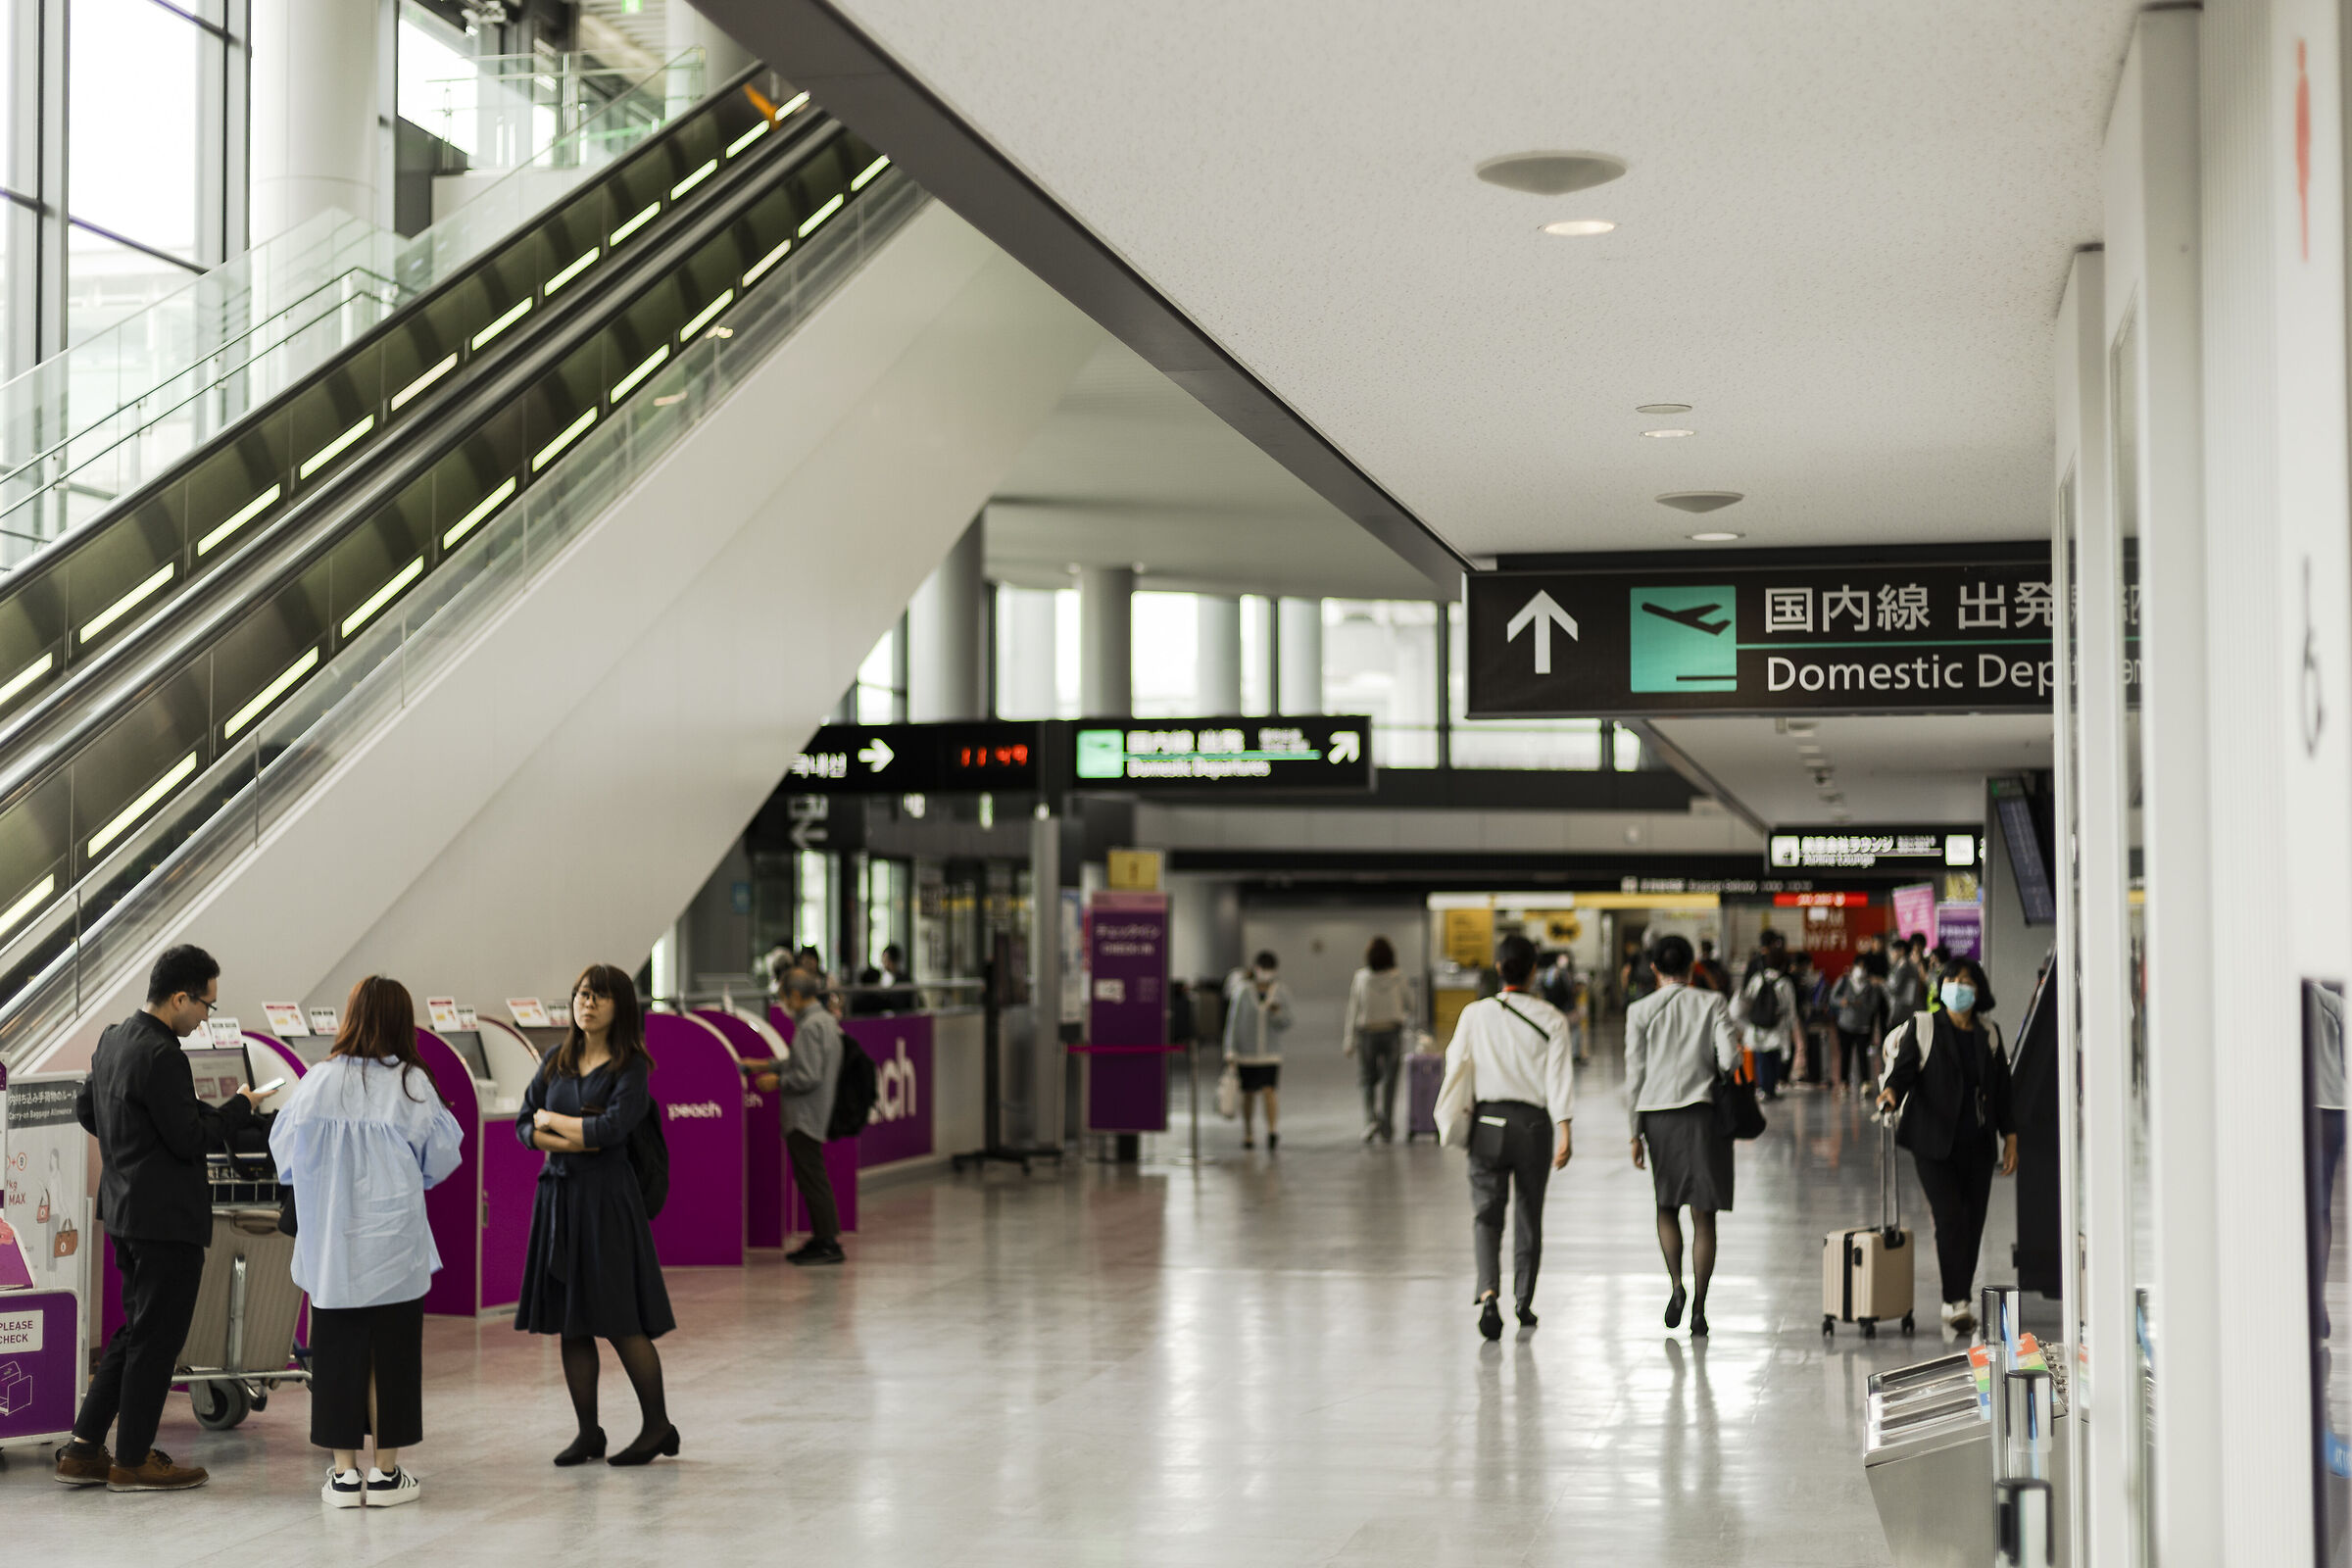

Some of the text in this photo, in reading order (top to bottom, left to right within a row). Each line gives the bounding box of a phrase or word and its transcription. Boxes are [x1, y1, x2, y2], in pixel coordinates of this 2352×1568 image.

[1765, 583, 1931, 634] 国内線
[1767, 654, 1964, 692] Domestic
[666, 1100, 723, 1121] peach
[9, 1192, 25, 1205] MAX
